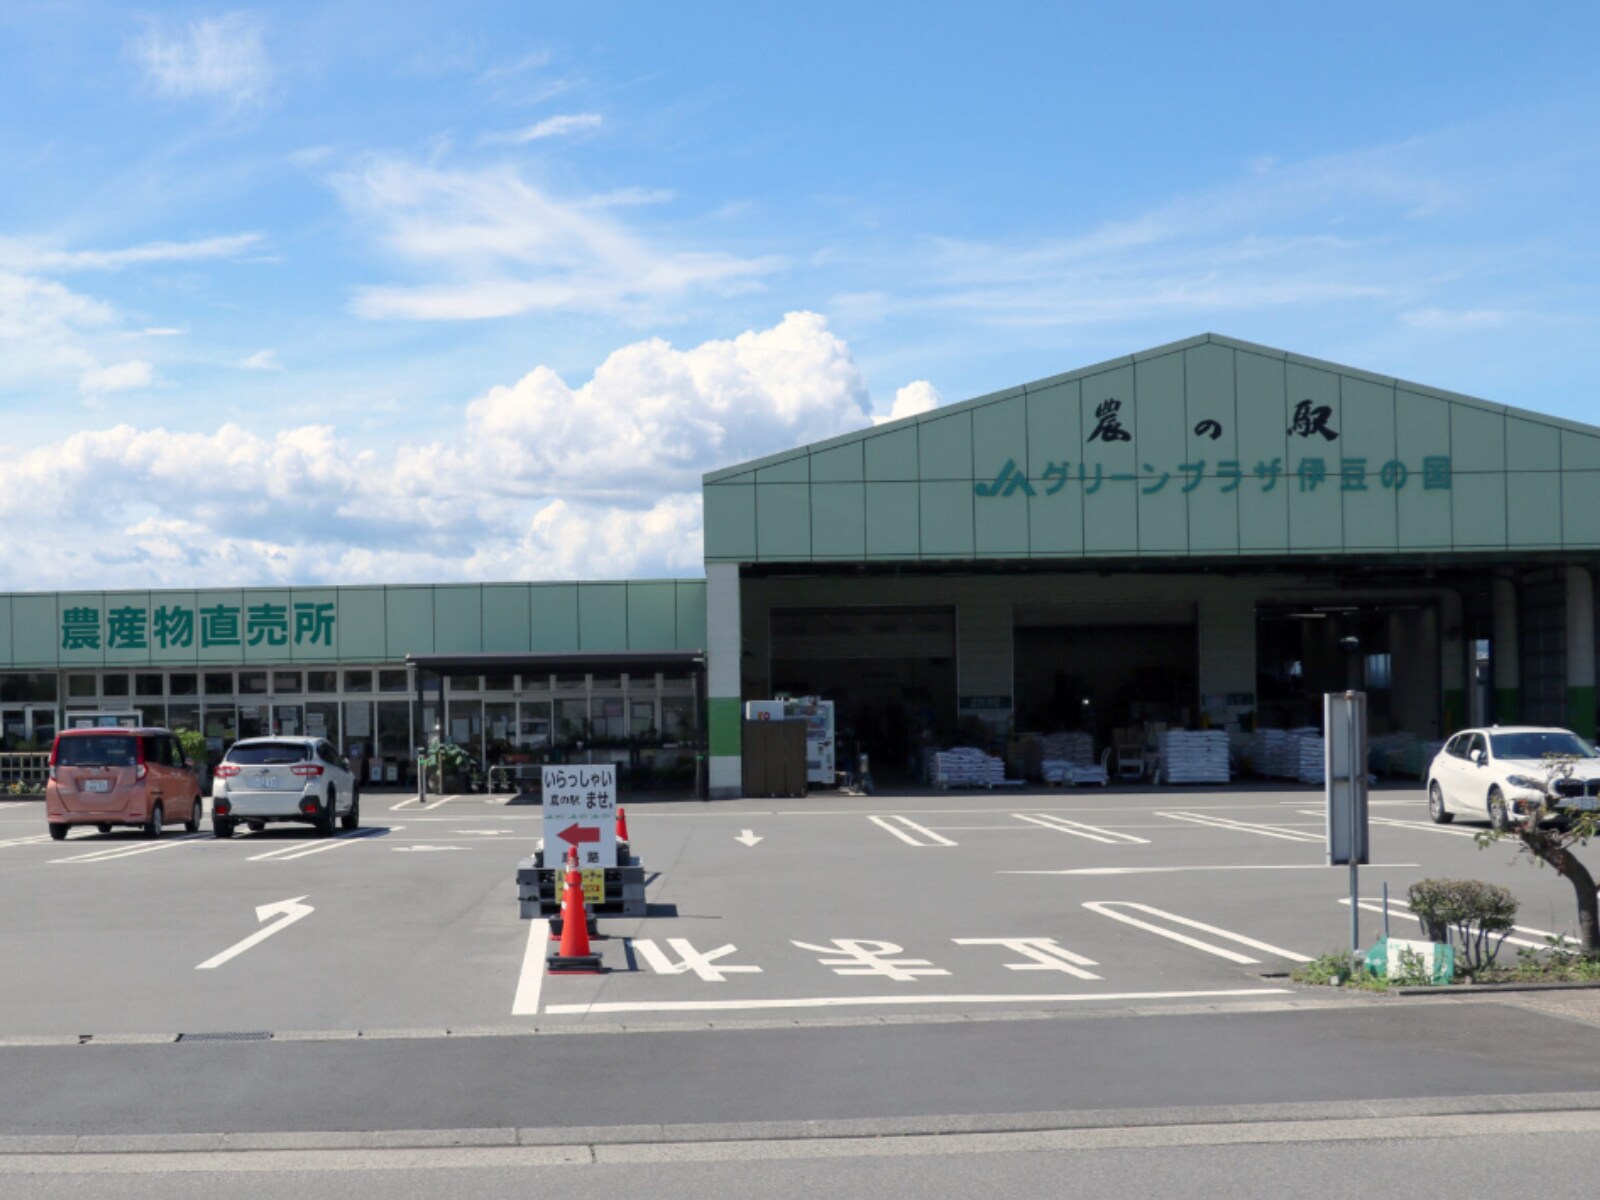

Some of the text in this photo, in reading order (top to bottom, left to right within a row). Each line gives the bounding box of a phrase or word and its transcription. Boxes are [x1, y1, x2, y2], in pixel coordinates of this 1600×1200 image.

[1086, 398, 1339, 442] 農の駅
[975, 456, 1451, 497] JAグリーンプラザ伊豆の国
[61, 602, 335, 650] 農産物直売所
[544, 769, 612, 789] いらっしゃい
